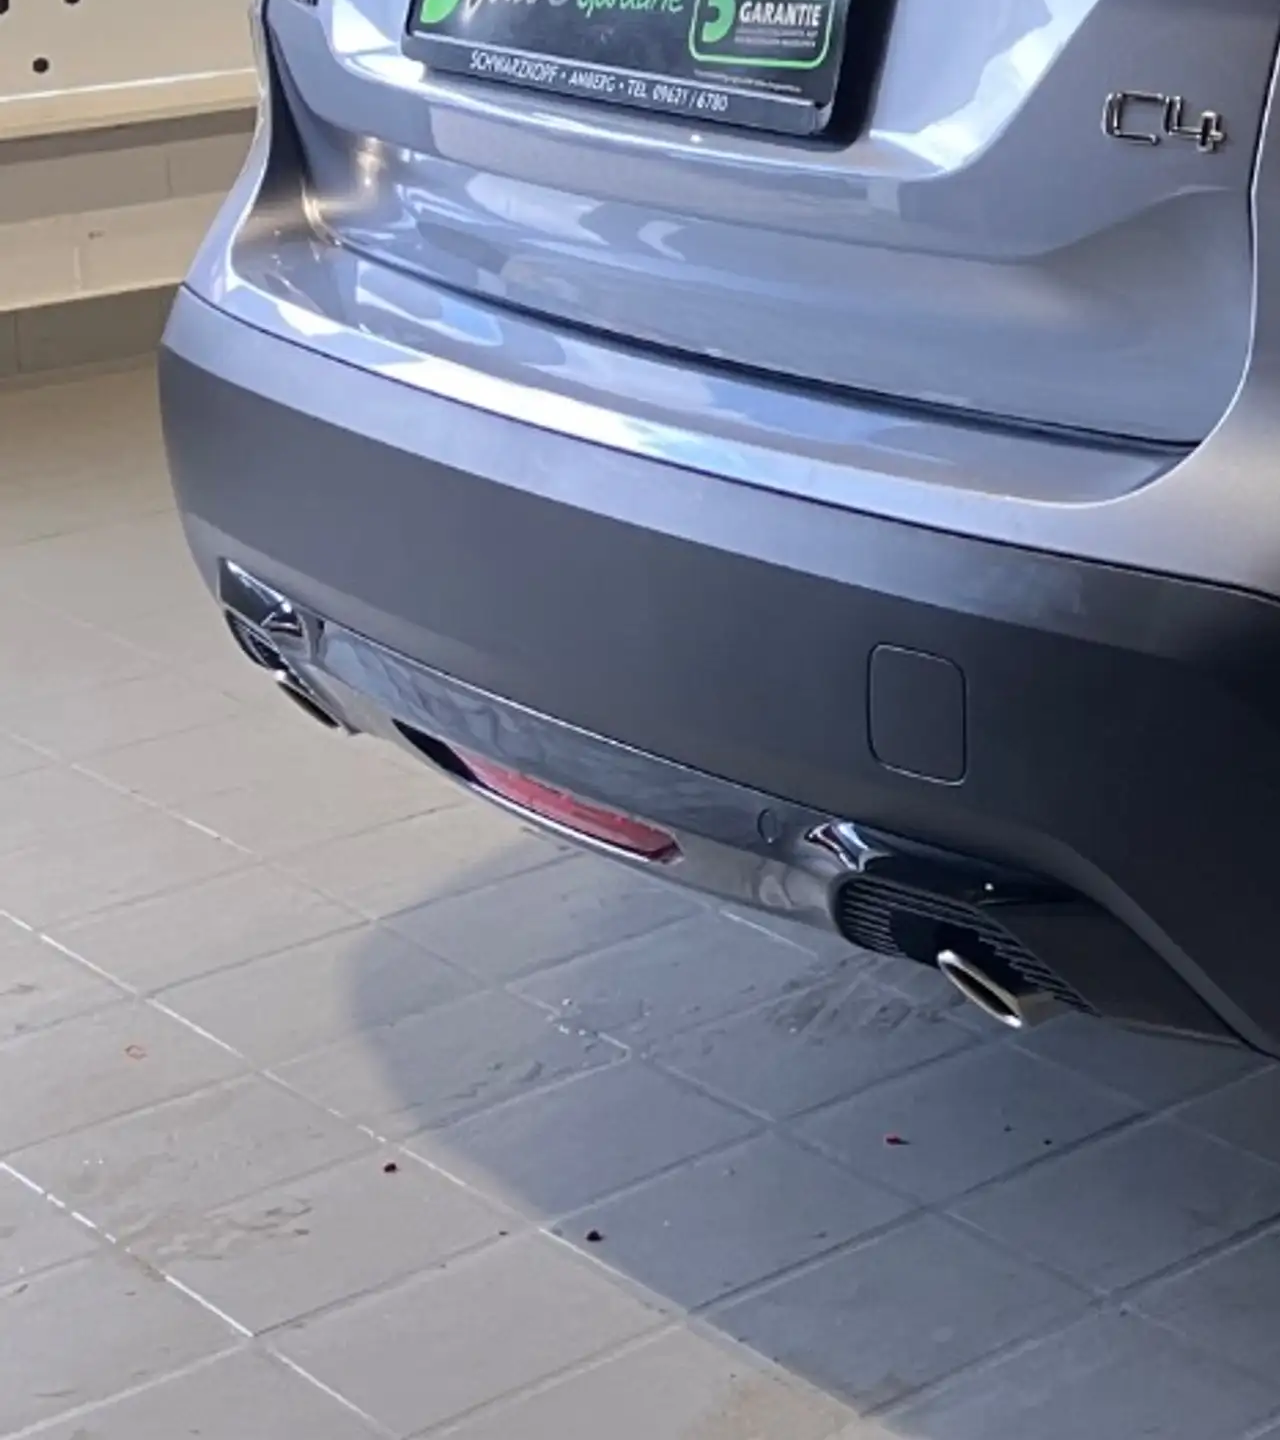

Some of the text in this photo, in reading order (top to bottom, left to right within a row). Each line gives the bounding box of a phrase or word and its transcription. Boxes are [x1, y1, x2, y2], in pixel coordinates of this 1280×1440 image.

[739, 0, 822, 27] GARANTIE
[469, 50, 559, 83] SCHWARZKOPF
[1101, 90, 1224, 152] C4
